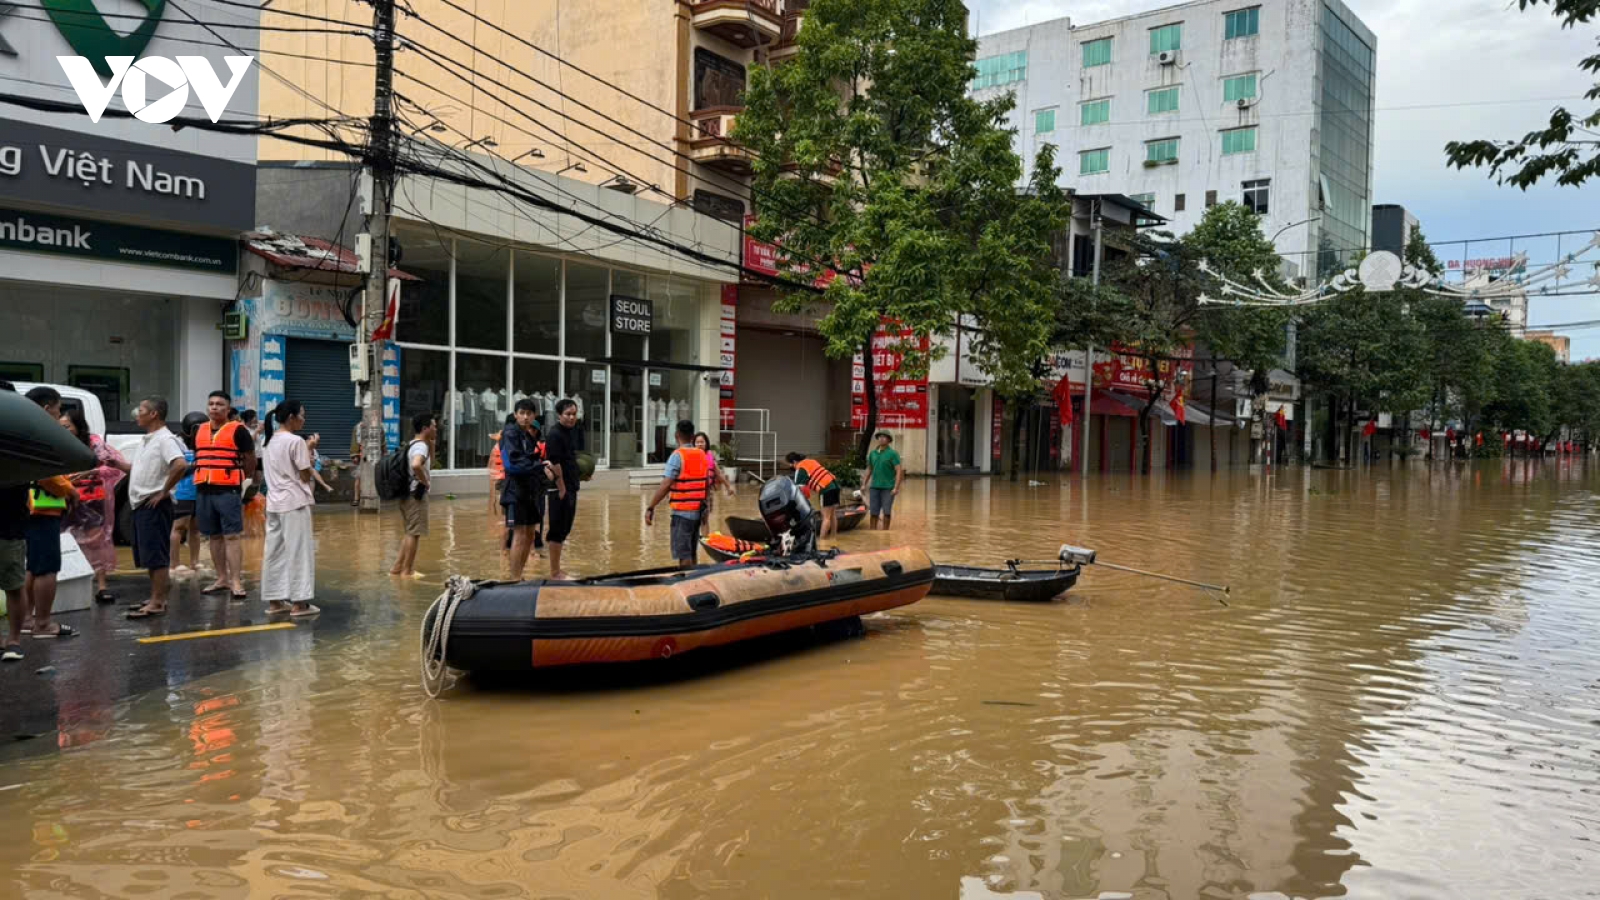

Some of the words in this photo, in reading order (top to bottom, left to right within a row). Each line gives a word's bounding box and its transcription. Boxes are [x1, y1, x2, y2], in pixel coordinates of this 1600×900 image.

[39, 144, 113, 187] Việt
[126, 159, 205, 199] Nam
[119, 247, 222, 266] www.vietcombank.com.vn
[615, 300, 651, 317] SEOUL
[615, 316, 651, 332] STORE
